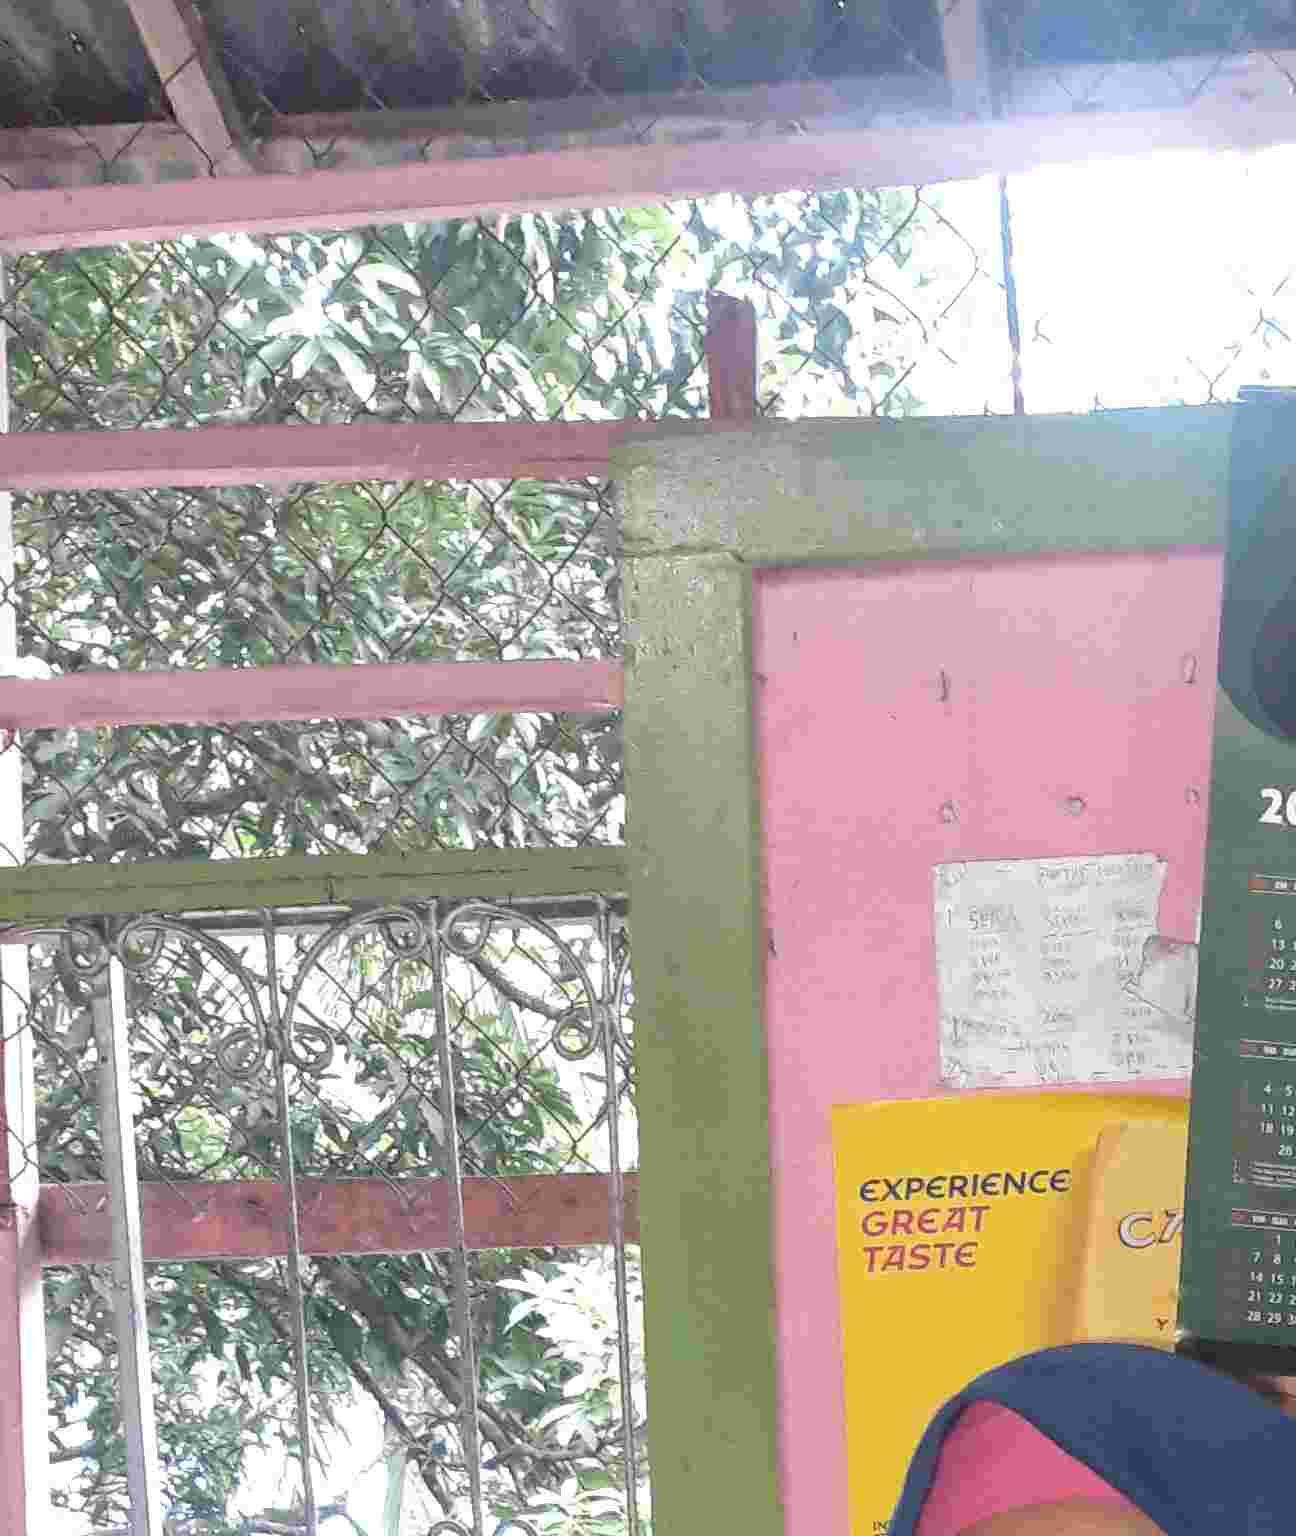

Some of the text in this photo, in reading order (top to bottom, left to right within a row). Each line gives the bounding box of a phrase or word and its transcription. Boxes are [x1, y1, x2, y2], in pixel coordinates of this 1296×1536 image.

[859, 1169, 1071, 1202] EXPERIENCE
[861, 1205, 991, 1237] GREAT
[863, 1242, 979, 1273] TASTE
